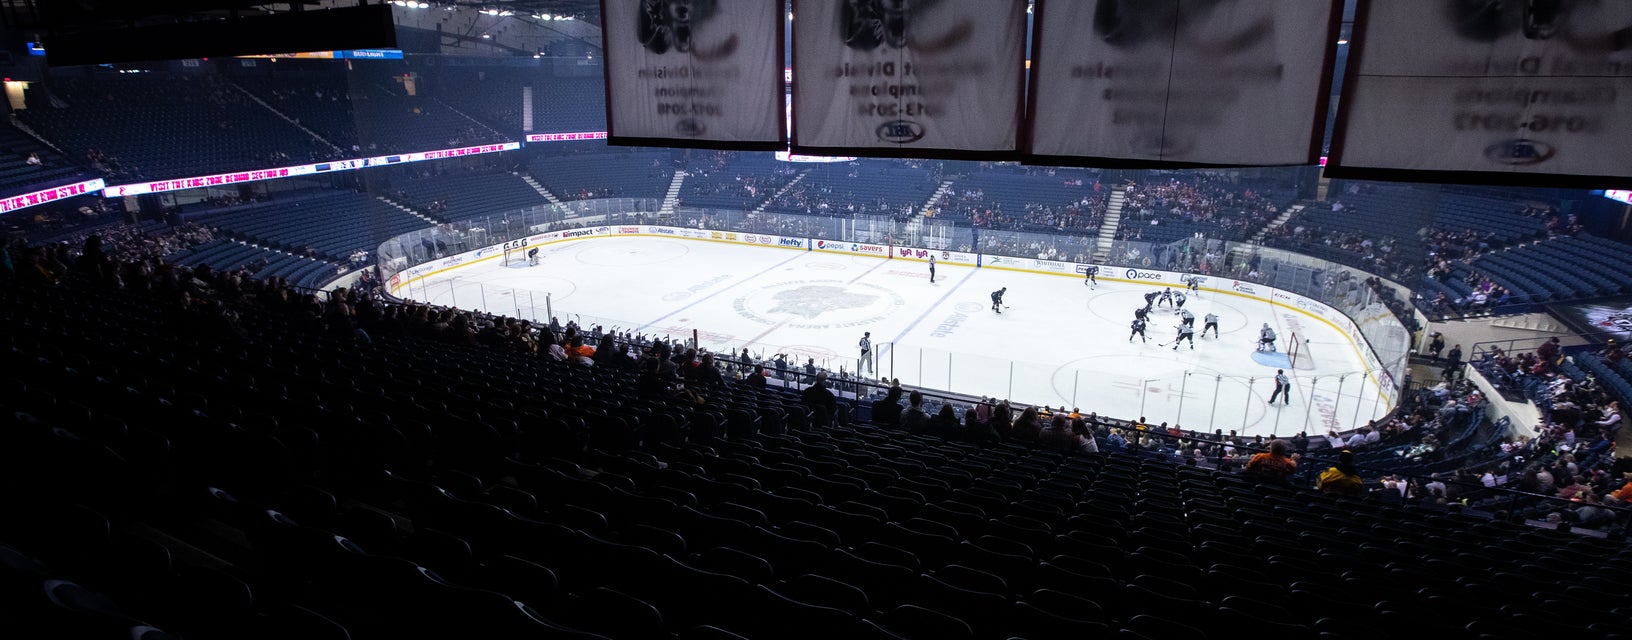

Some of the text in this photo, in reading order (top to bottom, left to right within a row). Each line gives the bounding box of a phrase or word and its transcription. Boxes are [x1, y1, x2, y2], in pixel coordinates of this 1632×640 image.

[150, 181, 169, 192] VISIT
[172, 179, 185, 190] THE
[187, 178, 204, 188] KIDS
[206, 176, 223, 186] ZONE
[568, 228, 593, 239] impact
[780, 238, 802, 247] Hefty
[859, 244, 883, 252] savers
[900, 248, 928, 259] lyft lyft
[1137, 271, 1161, 280] pace
[930, 311, 968, 338] Allstate
